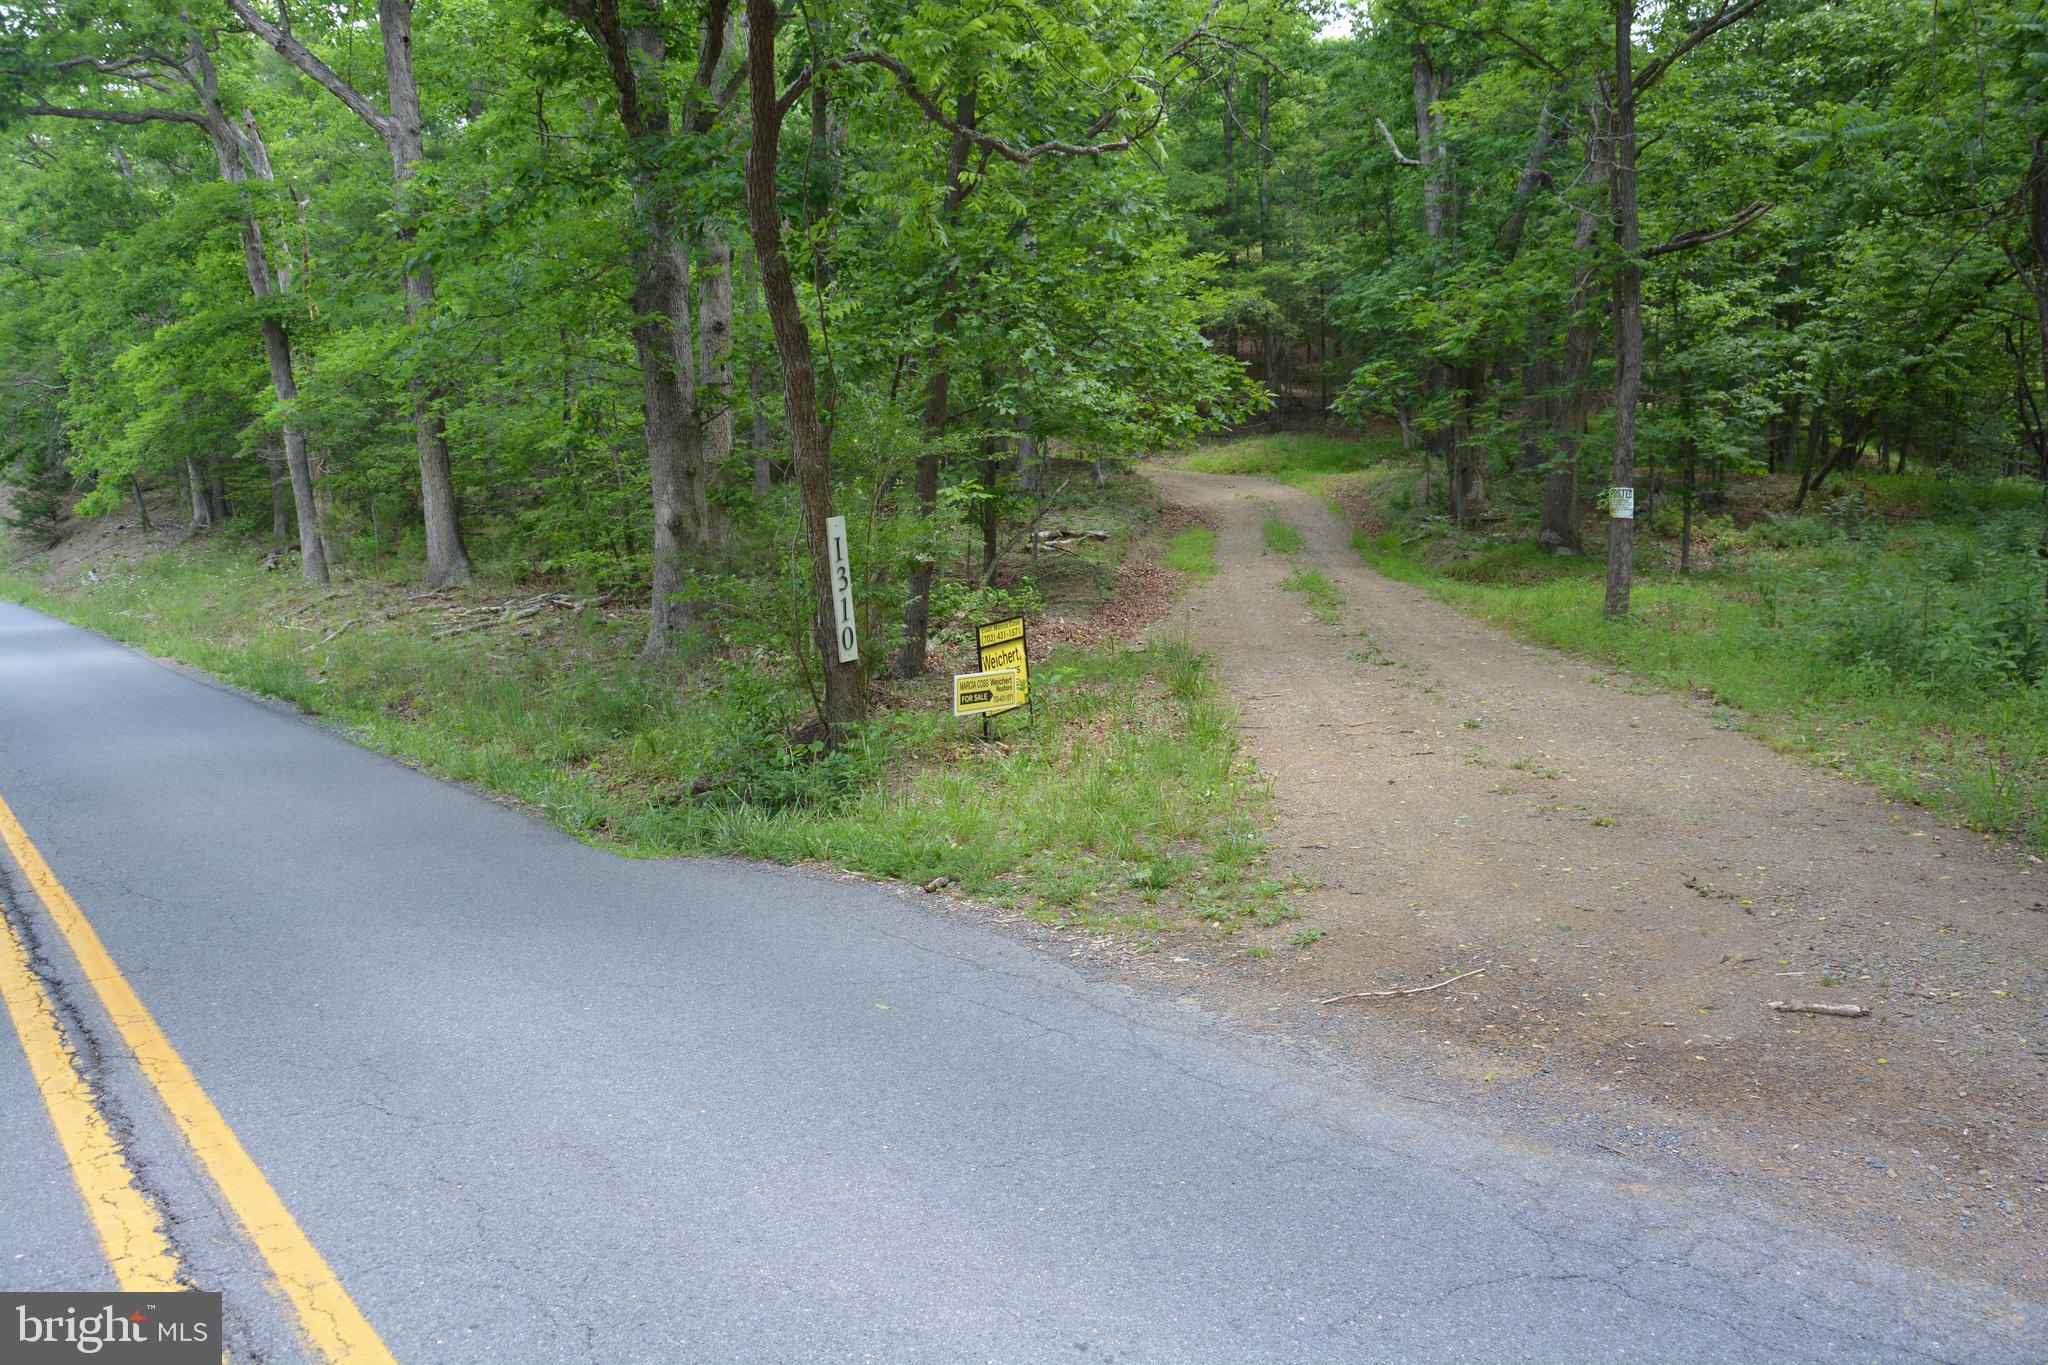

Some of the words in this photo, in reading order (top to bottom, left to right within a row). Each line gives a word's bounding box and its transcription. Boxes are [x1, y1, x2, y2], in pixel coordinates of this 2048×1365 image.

[834, 536, 854, 651] 1310
[981, 633, 995, 645] (703)
[997, 626, 1021, 639] 431-1571
[960, 680, 976, 691] MARCIA
[977, 678, 989, 688] COSS
[961, 694, 973, 703] FOR
[974, 692, 988, 702] SALE
